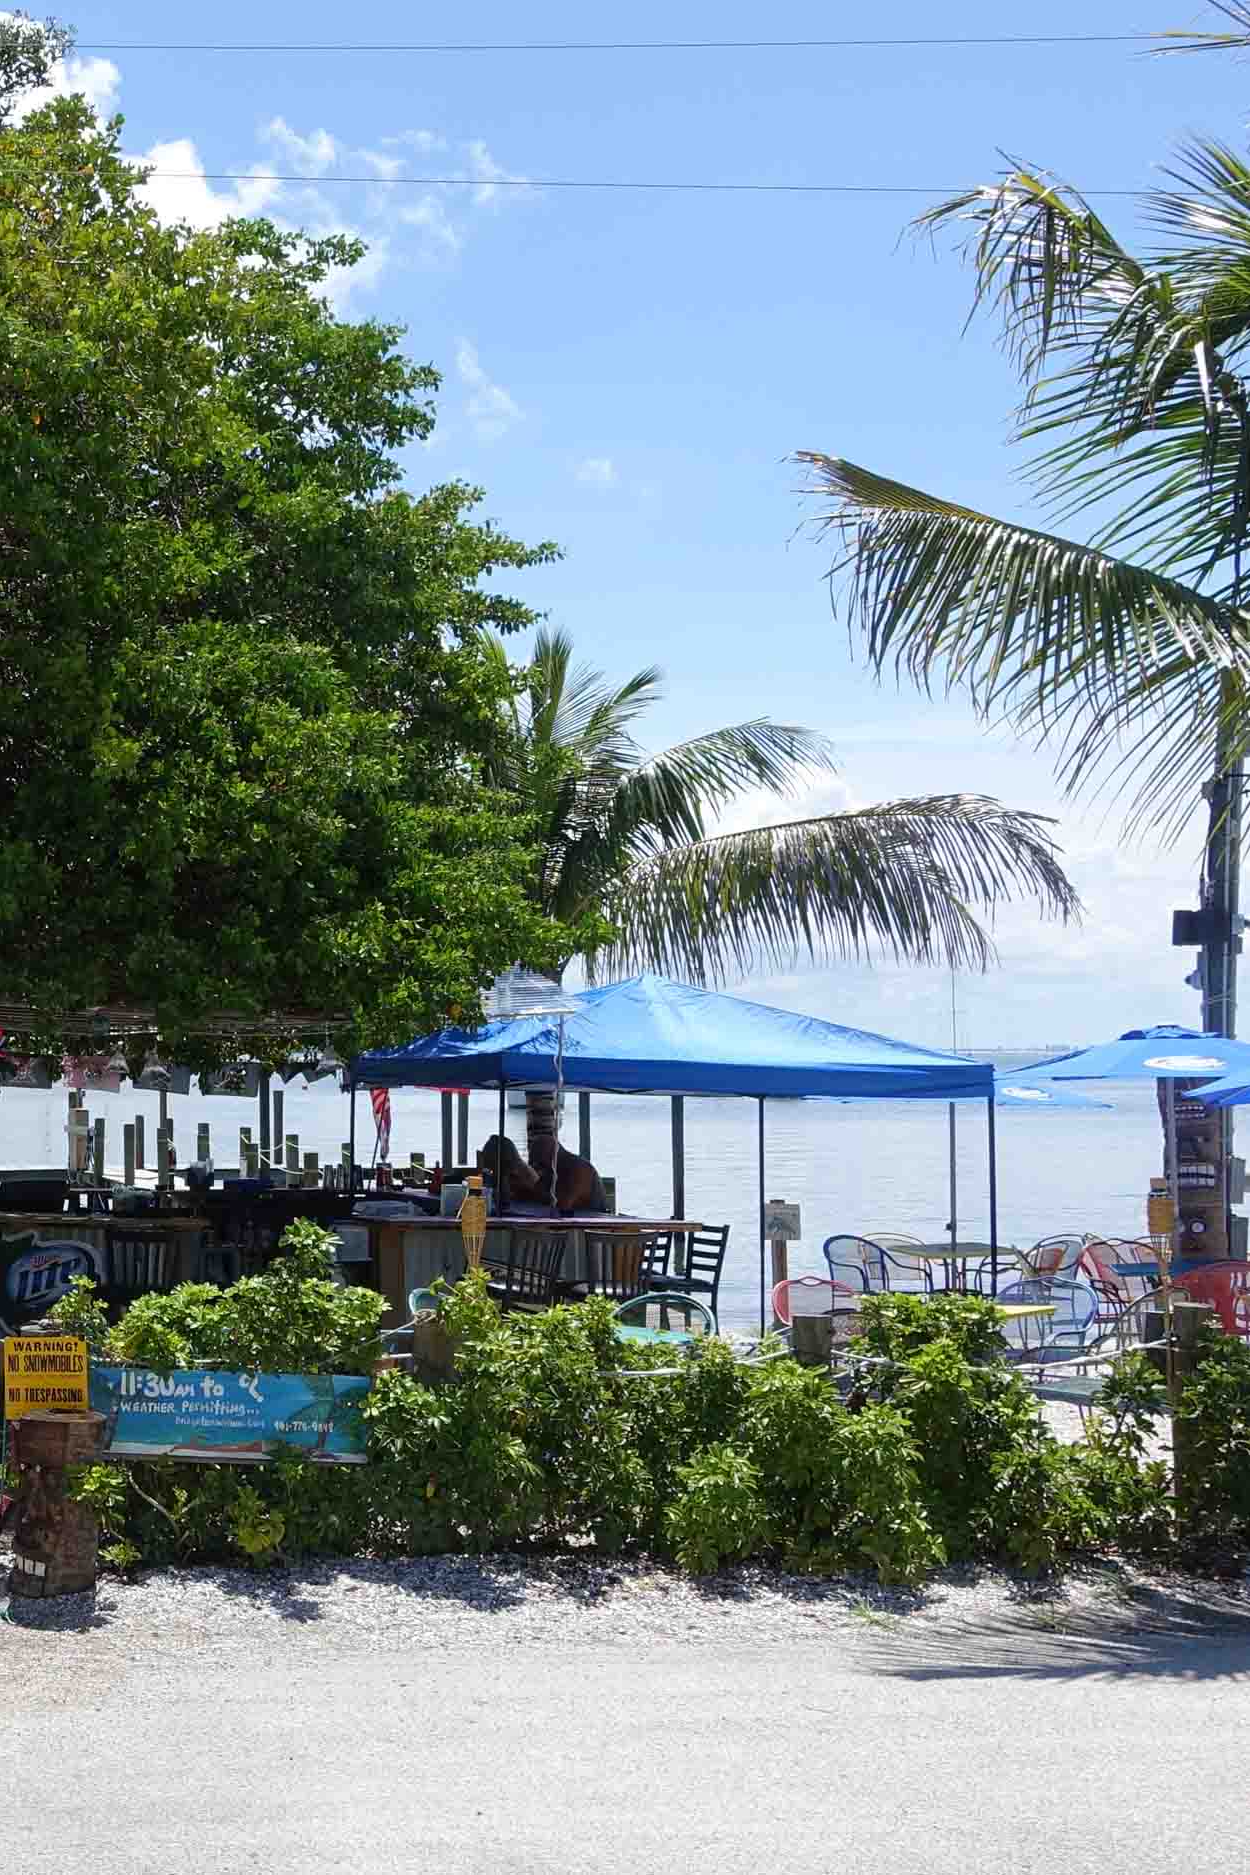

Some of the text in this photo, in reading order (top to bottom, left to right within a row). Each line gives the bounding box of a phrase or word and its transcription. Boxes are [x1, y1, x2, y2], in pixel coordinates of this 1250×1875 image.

[13, 1341, 79, 1352] WARNING!
[8, 1354, 84, 1373] NO SNOWMOBILES
[8, 1387, 83, 1402] NO TRESPASSING
[120, 1401, 176, 1414] WEATHER
